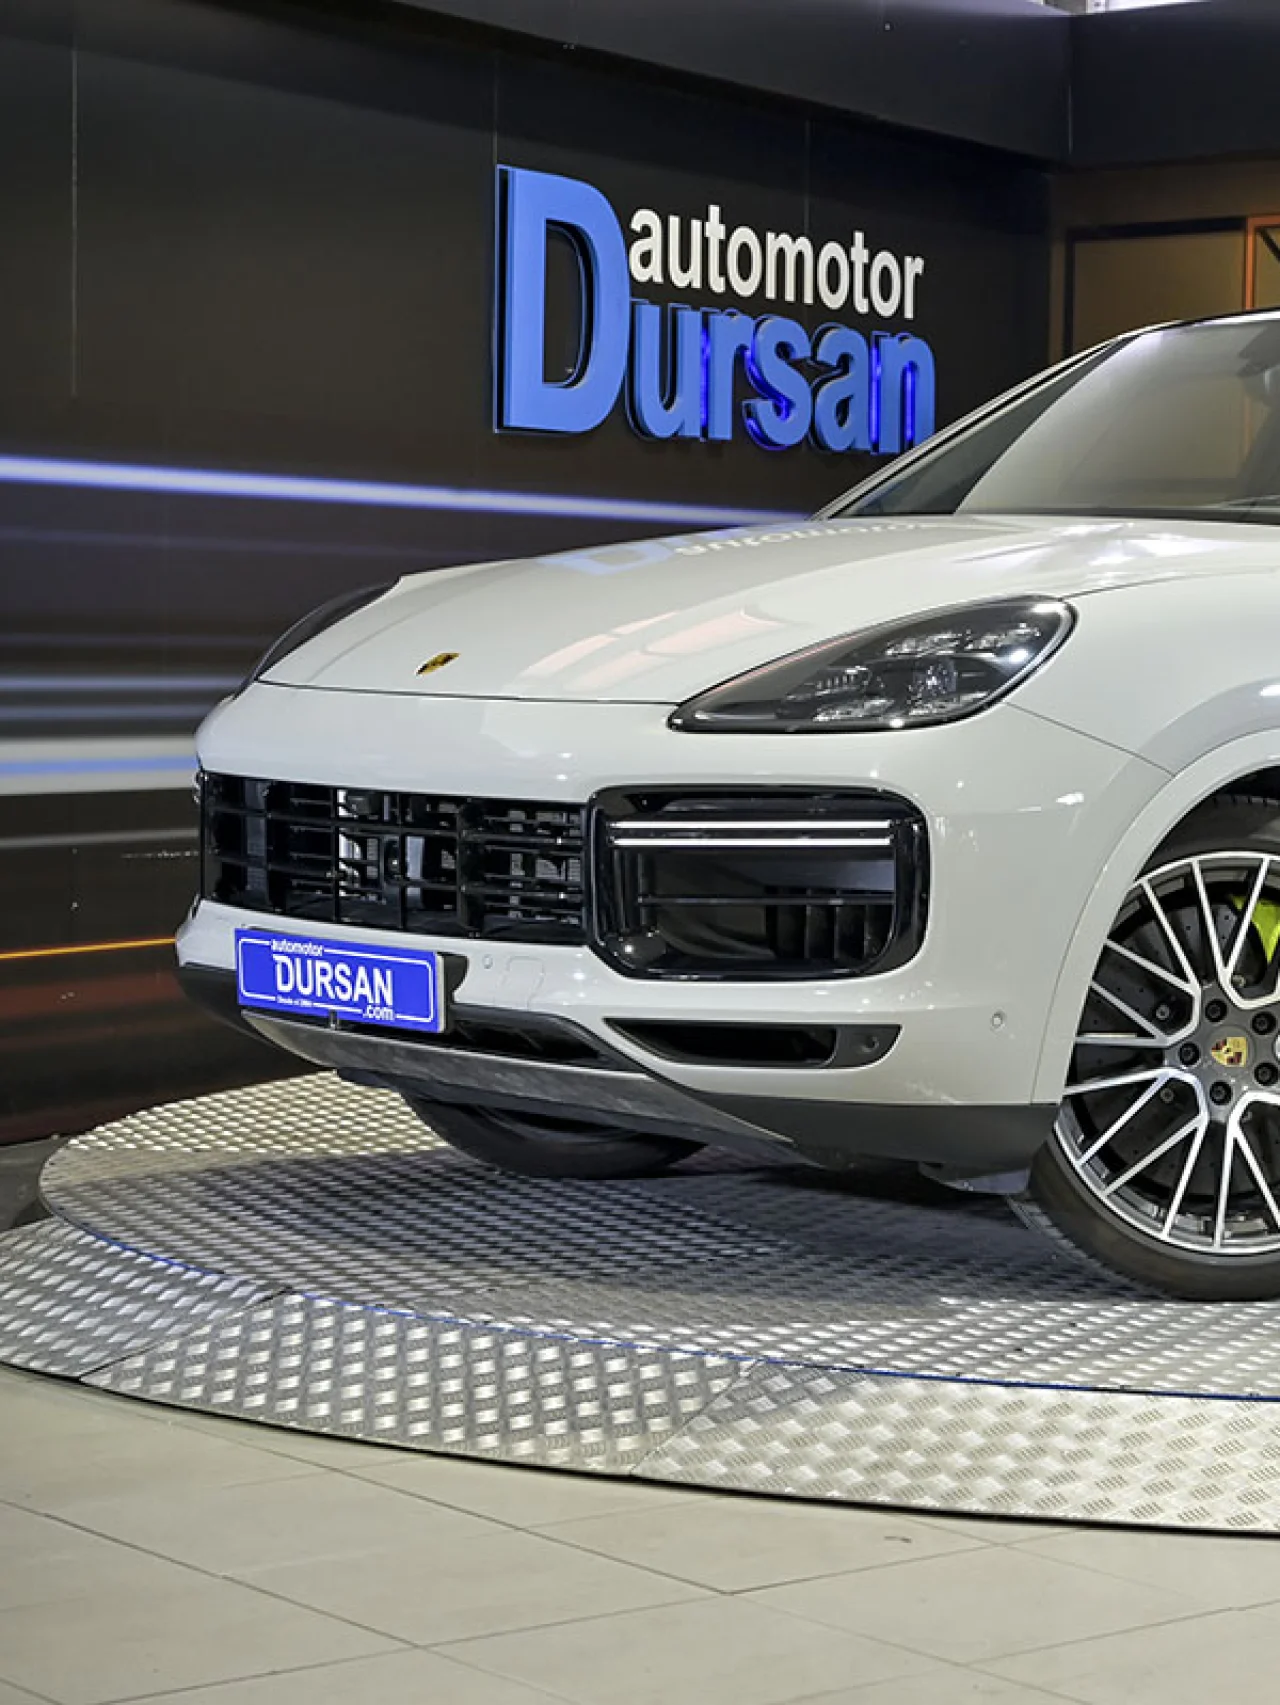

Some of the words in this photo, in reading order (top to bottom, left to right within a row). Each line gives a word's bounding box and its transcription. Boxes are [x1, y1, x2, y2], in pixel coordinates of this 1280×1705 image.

[628, 204, 924, 320] automotor
[494, 164, 936, 455] Dursan
[270, 939, 324, 956] automotor
[272, 954, 394, 1006] DURSAN
[362, 1004, 396, 1021] .com
